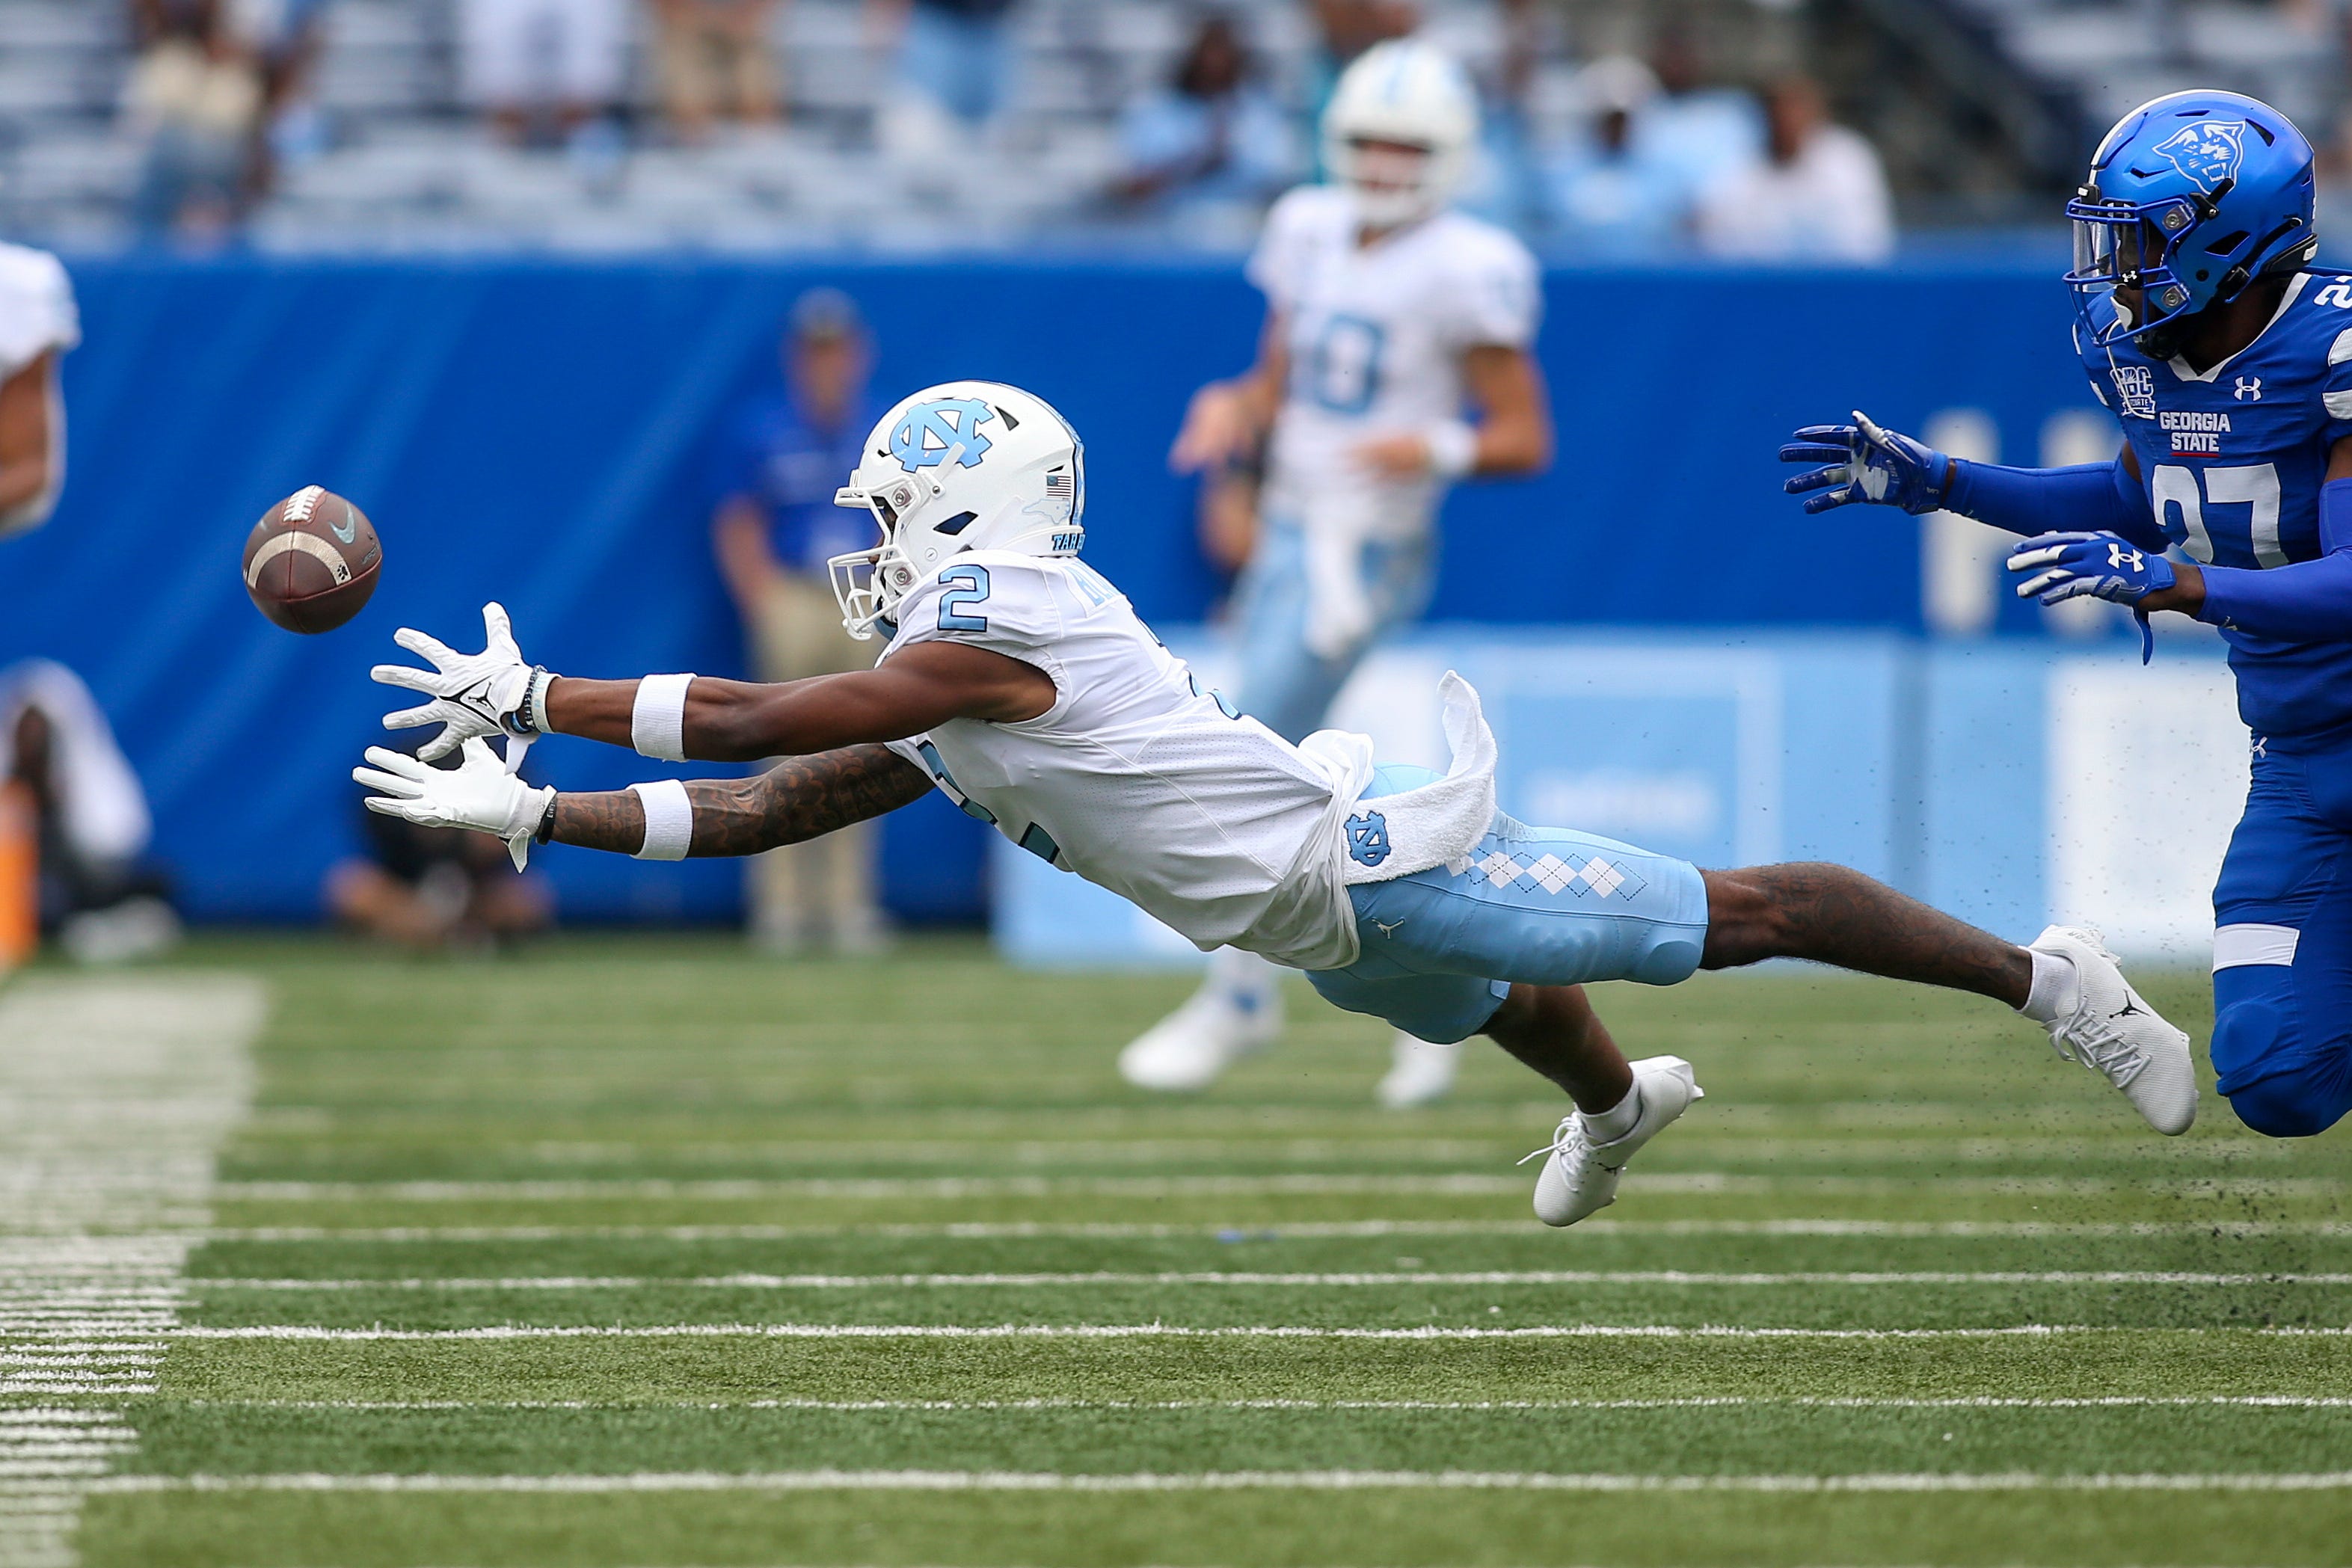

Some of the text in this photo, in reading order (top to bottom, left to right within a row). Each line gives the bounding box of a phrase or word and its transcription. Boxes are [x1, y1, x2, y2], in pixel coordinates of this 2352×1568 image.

[2160, 412, 2231, 432] GEORGIA
[2171, 432, 2220, 452] STATE
[2152, 462, 2290, 571] 27
[937, 564, 990, 633] 2
